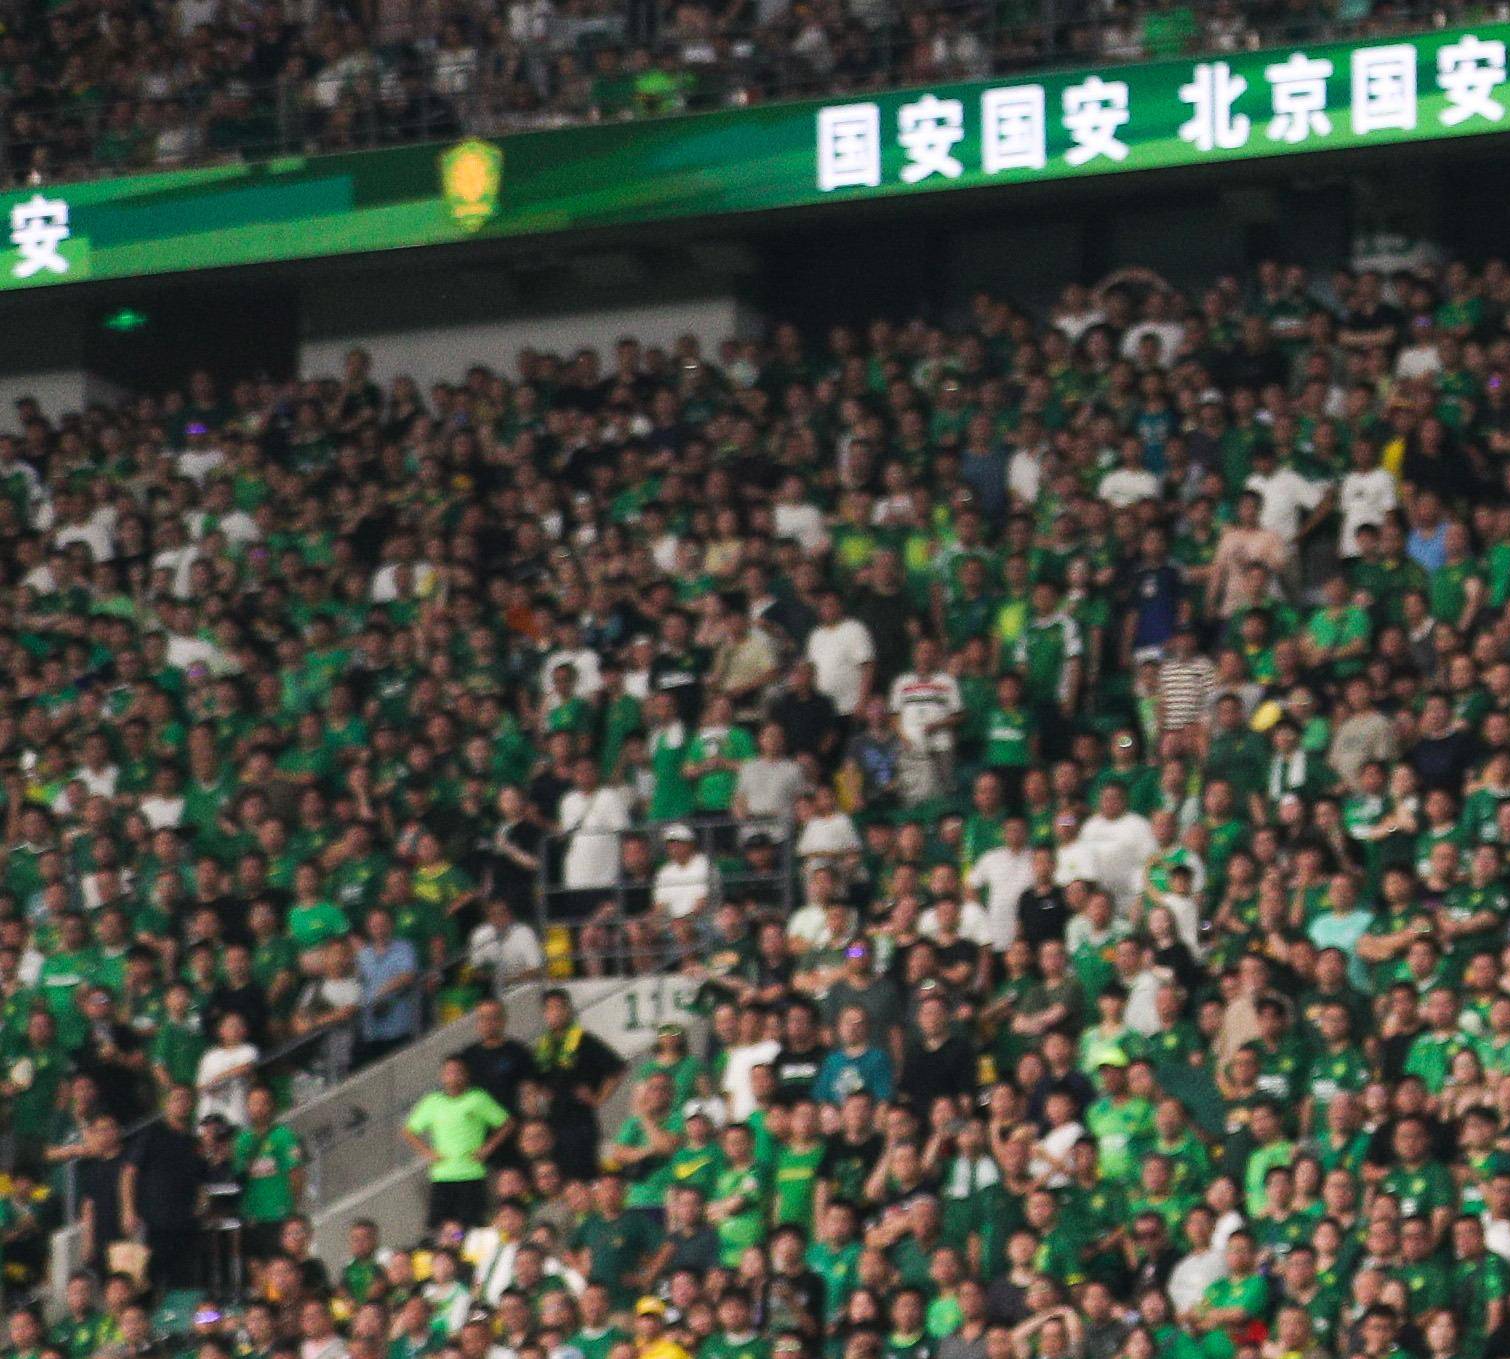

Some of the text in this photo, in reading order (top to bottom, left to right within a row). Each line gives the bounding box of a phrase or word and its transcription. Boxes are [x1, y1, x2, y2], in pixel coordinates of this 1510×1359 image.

[816, 35, 1508, 192] 国安国安 北京国安
[9, 194, 71, 279] 安
